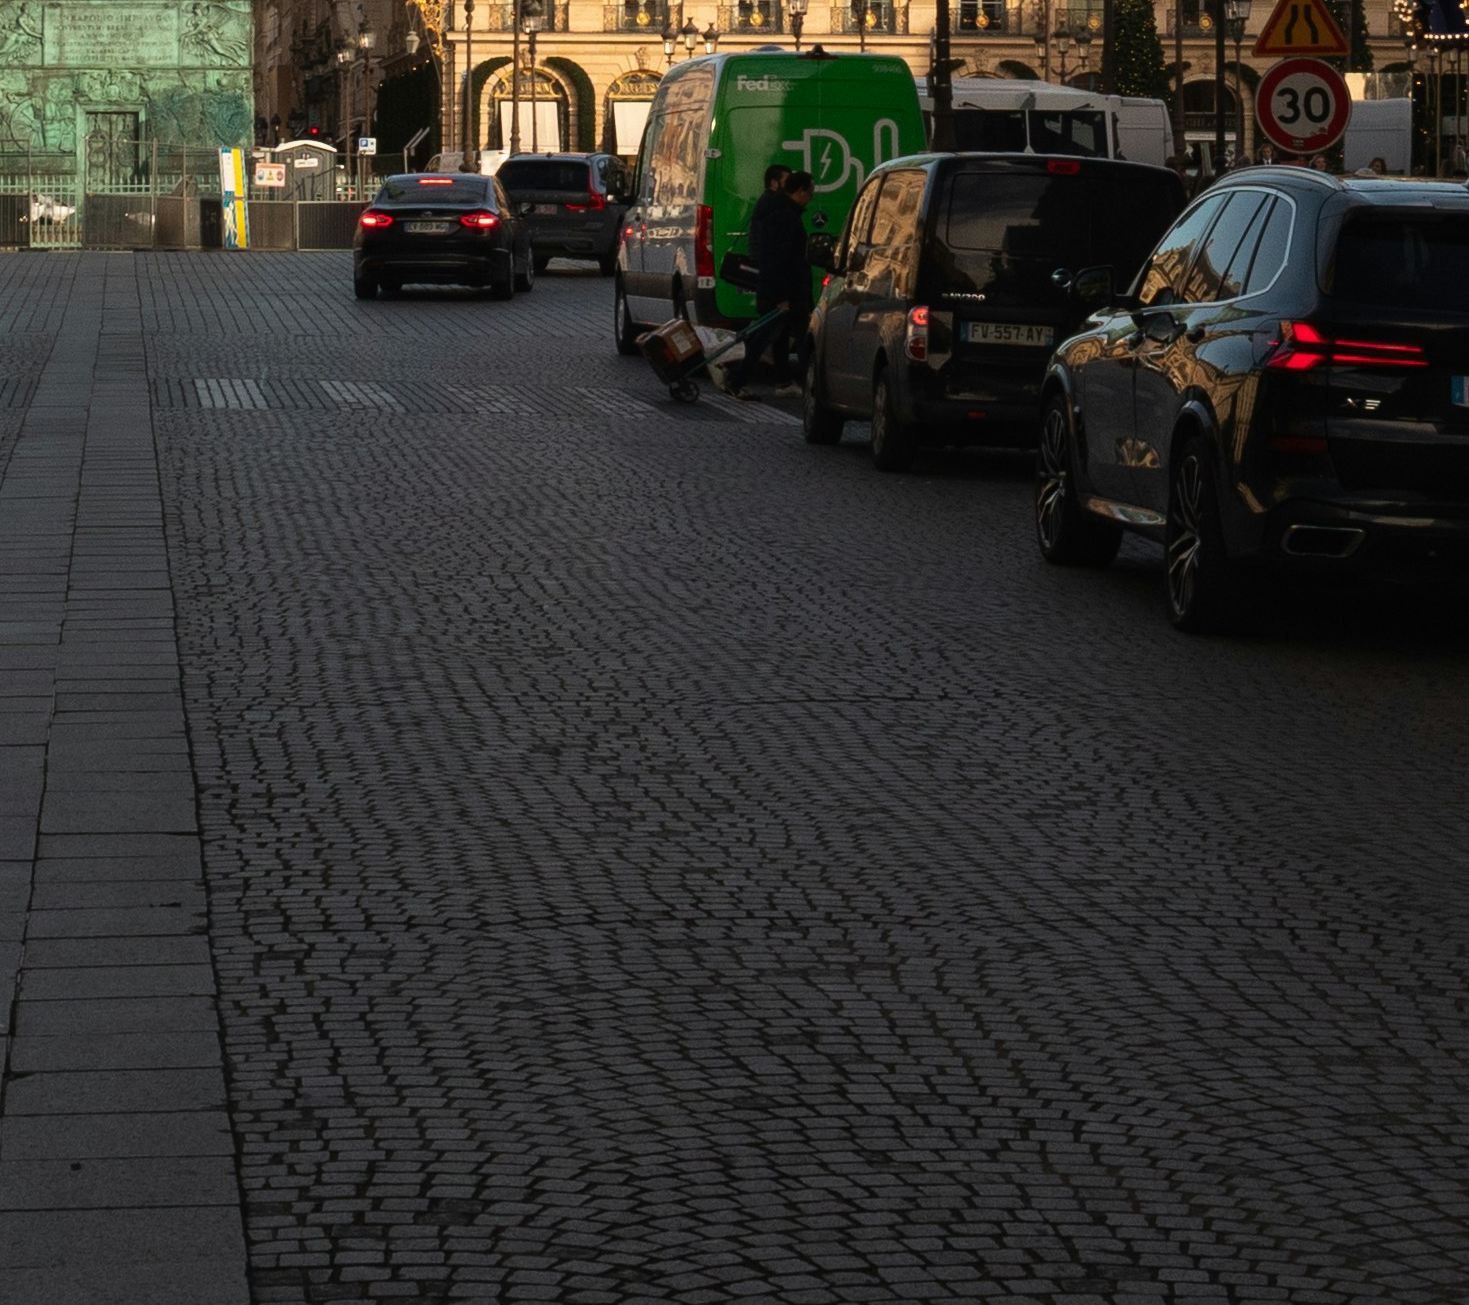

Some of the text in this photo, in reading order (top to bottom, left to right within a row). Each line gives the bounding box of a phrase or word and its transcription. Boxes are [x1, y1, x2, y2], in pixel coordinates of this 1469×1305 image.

[737, 74, 791, 91] FedEx
[1276, 86, 1331, 124] 30
[971, 324, 1044, 342] FV-557-AY
